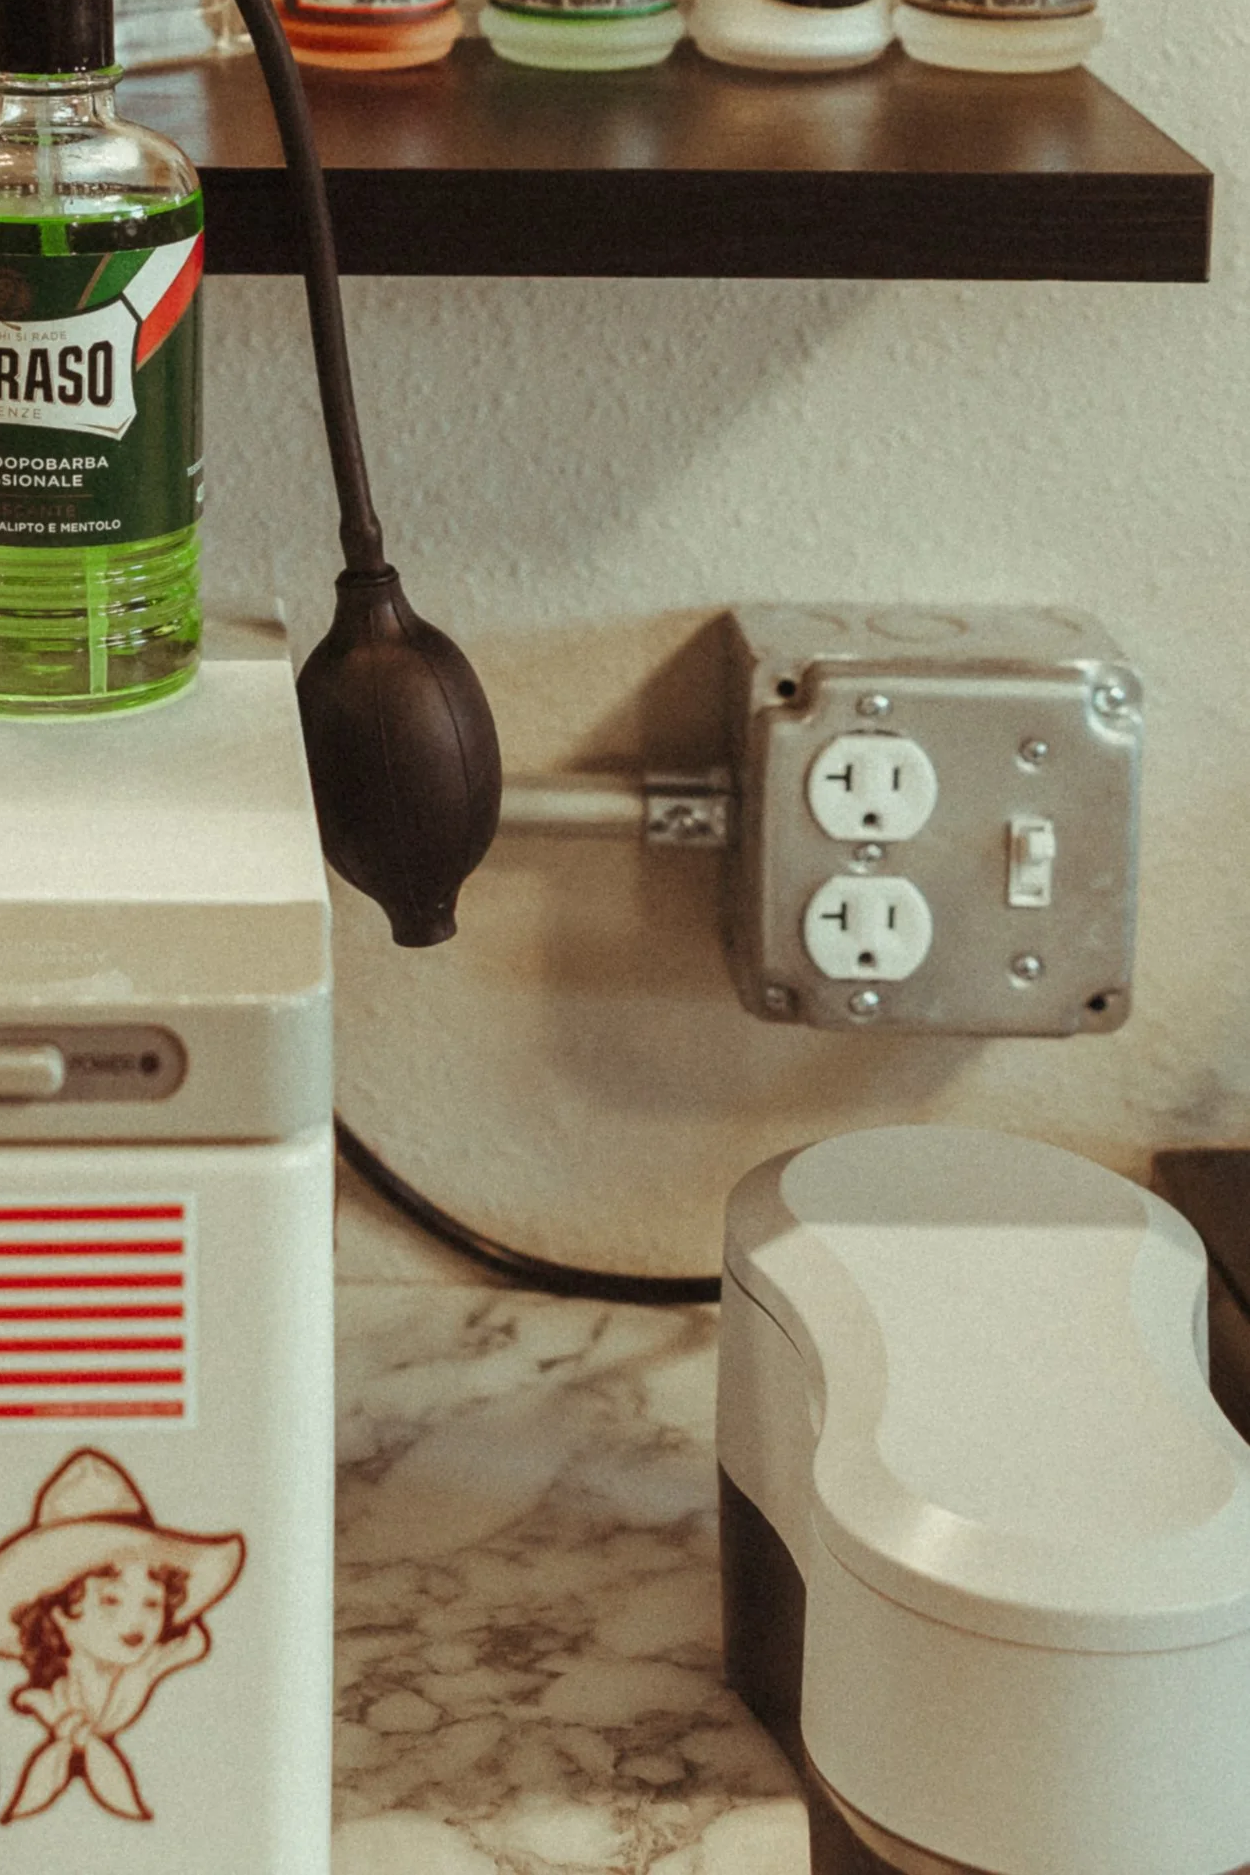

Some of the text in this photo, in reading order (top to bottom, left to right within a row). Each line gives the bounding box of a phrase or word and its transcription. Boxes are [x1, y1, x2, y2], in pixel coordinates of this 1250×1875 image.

[16, 331, 26, 341] SI
[31, 330, 67, 341] RADE
[48, 523, 56, 533] E
[60, 519, 121, 533] MENTOLO
